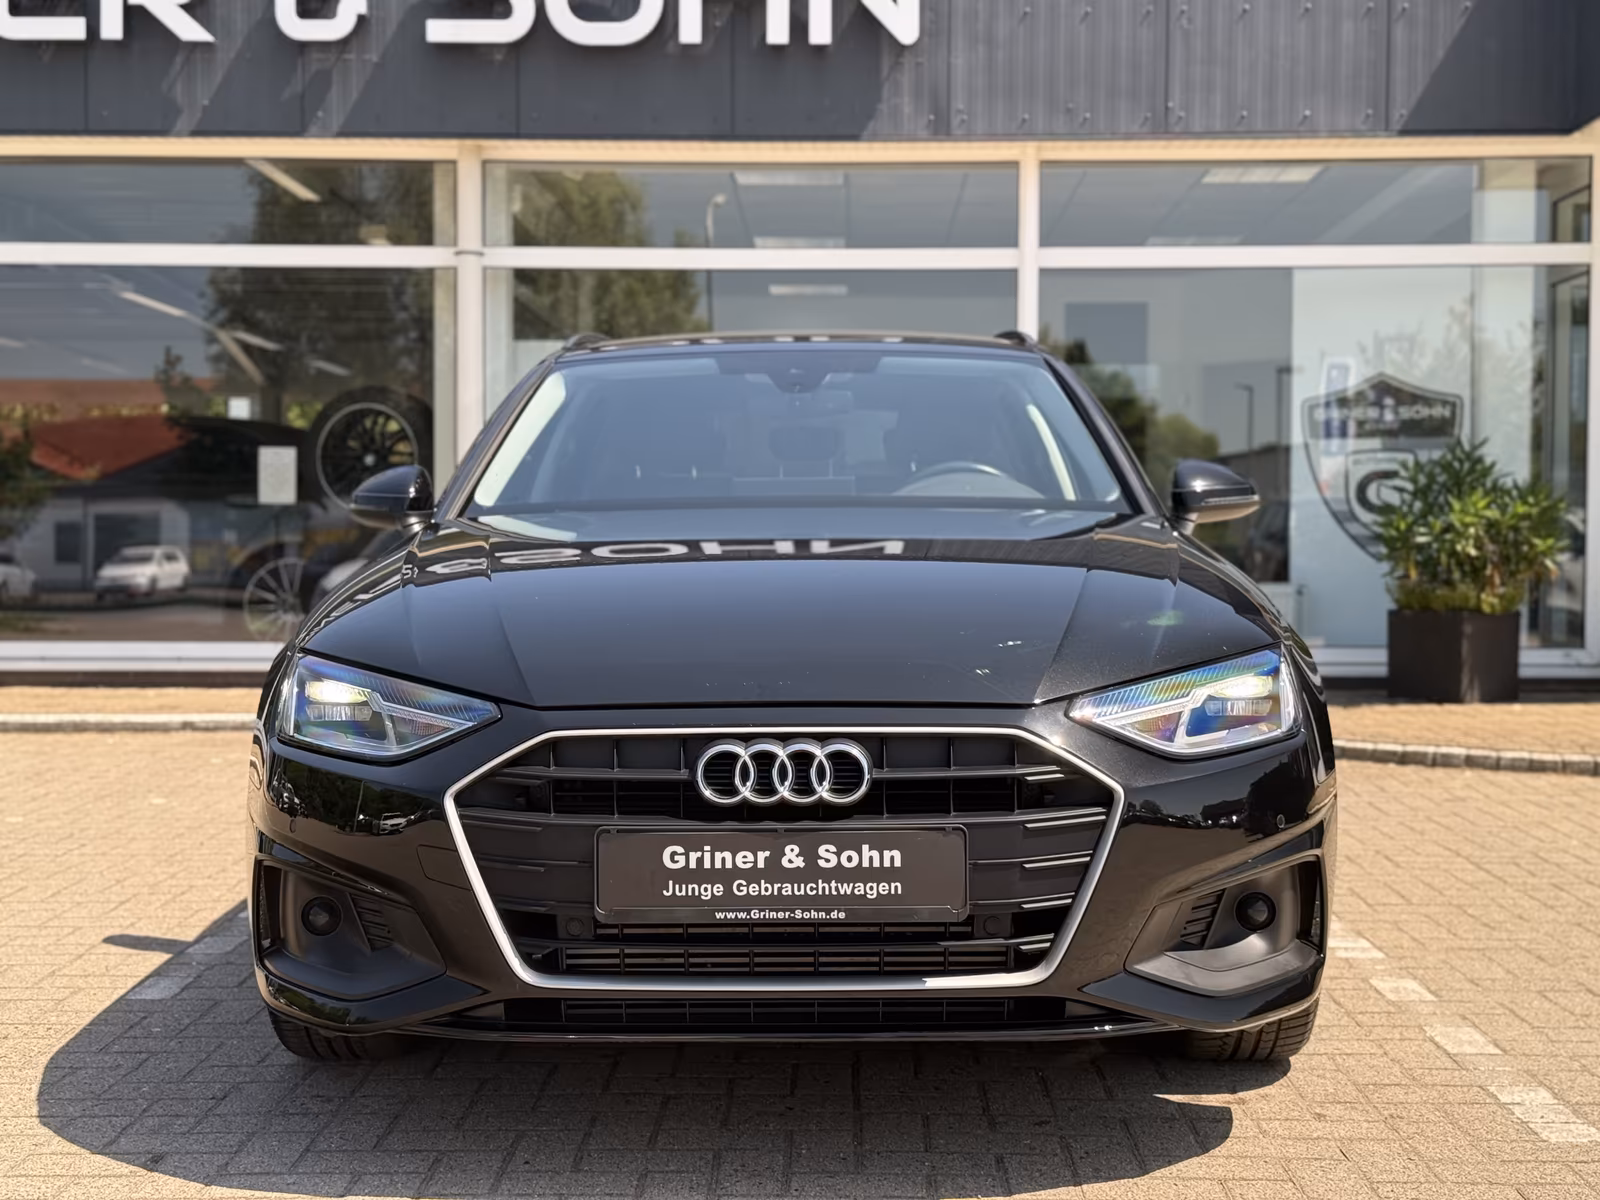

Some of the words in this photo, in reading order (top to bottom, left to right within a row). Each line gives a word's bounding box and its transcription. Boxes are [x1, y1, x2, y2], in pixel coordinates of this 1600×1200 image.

[662, 845, 771, 870] Griner
[781, 844, 806, 869] &
[817, 843, 902, 869] Sohn
[662, 880, 724, 900] Junge
[732, 878, 903, 899] Gebrauchtwagen
[715, 909, 846, 920] www.Griner-Sohn.de
